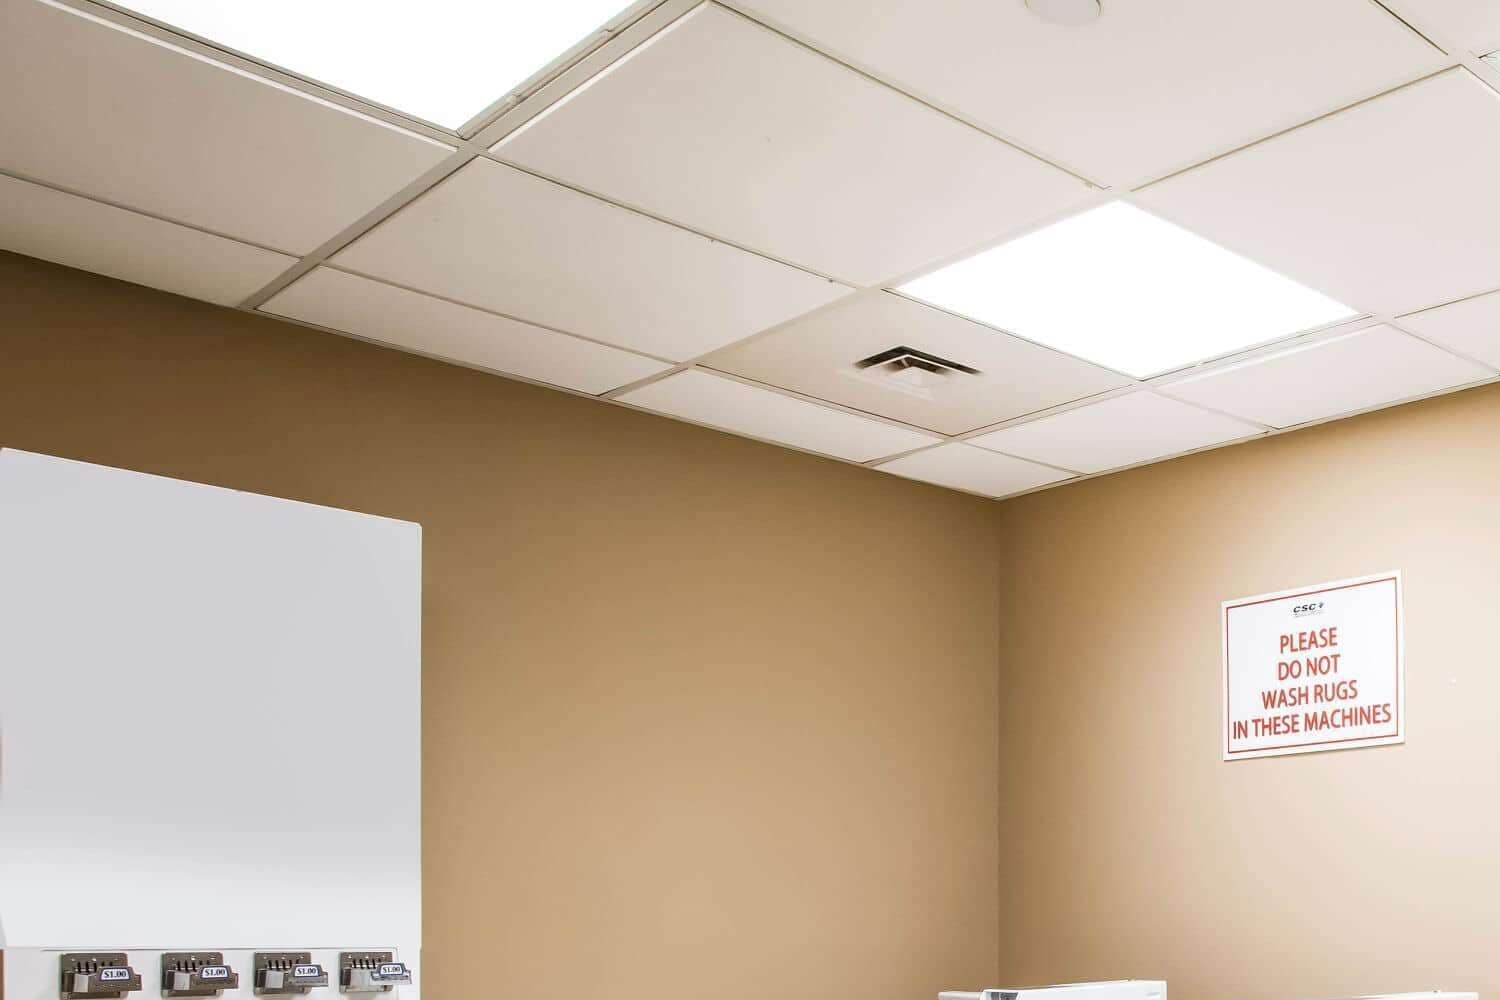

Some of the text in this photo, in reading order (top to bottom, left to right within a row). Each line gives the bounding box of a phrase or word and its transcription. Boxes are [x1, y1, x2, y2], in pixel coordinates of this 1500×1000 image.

[1292, 603, 1317, 613] CSC
[1279, 627, 1339, 654] PLEASE
[1277, 654, 1341, 681] DO NOT
[1261, 680, 1358, 710] WASH RUGS
[1232, 703, 1392, 739] IN THESE MACHINES
[103, 970, 127, 978] $1.00
[204, 969, 226, 977] $1.00
[296, 967, 317, 976] $1.00
[382, 966, 401, 974] $1.00
